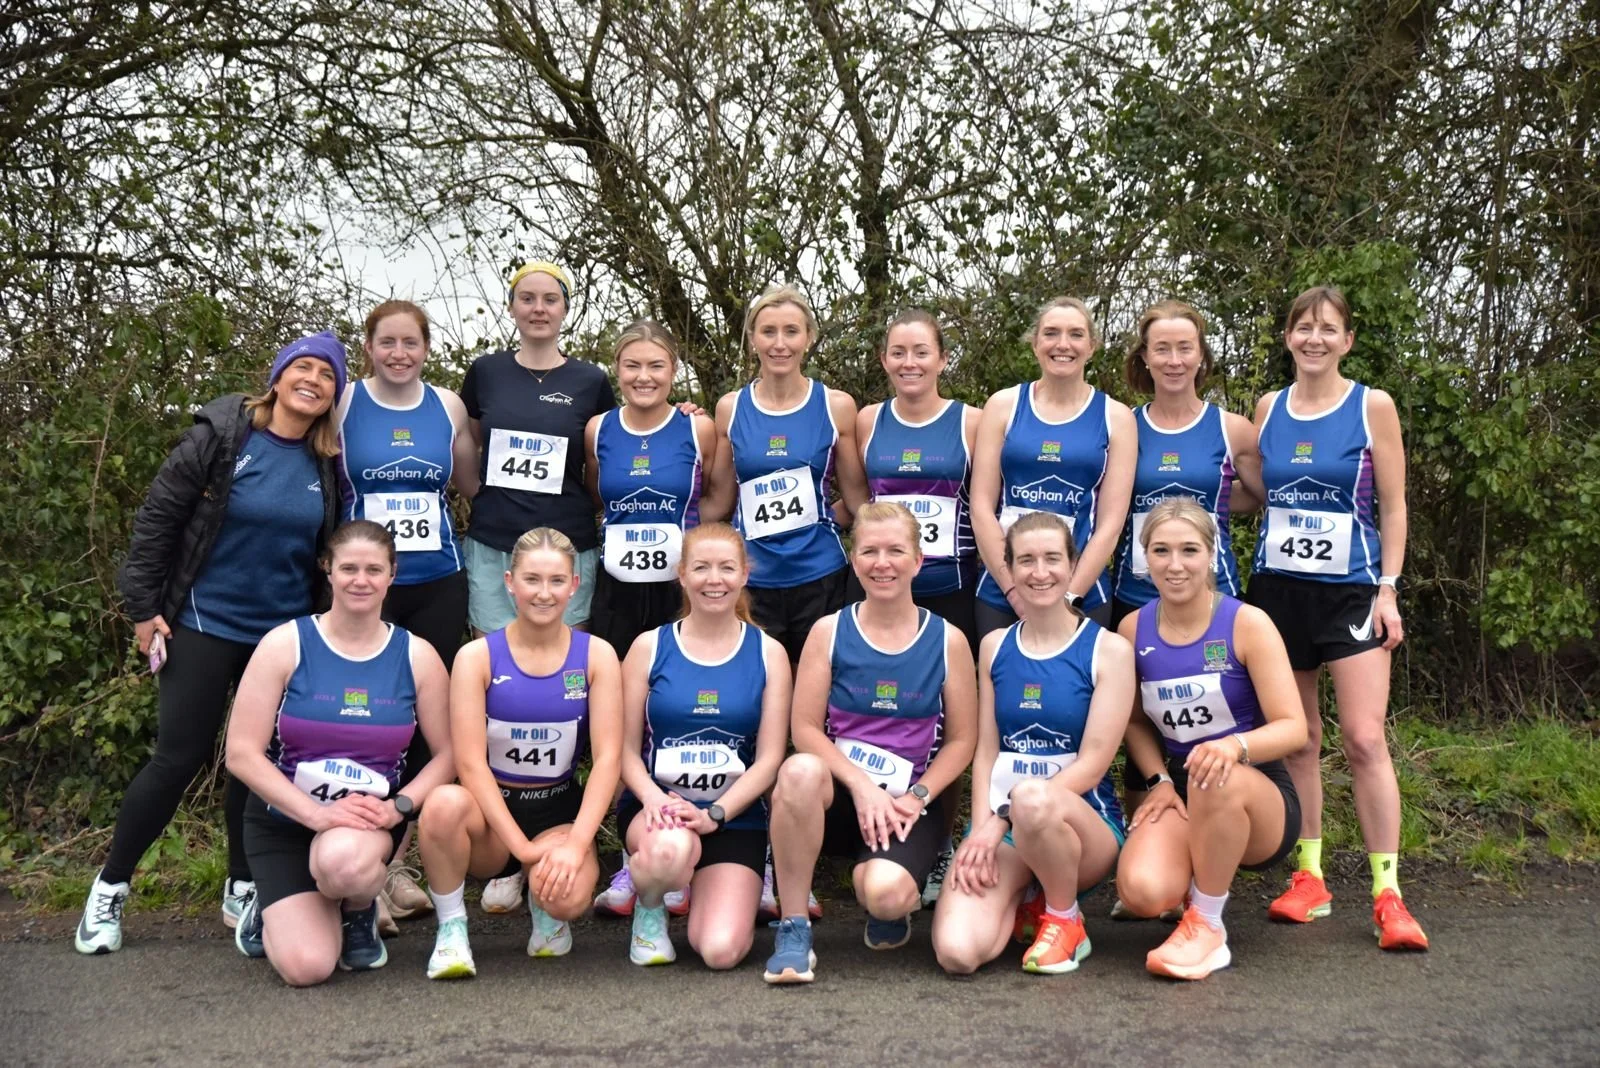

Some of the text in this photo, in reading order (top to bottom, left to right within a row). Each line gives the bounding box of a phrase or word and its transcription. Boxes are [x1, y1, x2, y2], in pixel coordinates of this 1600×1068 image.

[510, 435, 541, 451] Mr Oil
[362, 466, 443, 481] Croghan AC
[501, 457, 549, 480] 445
[754, 477, 787, 497] Mr Oil
[1011, 484, 1084, 504] Croghan AC
[386, 497, 421, 511] Mr Oil
[1268, 488, 1341, 505] Croghan AC
[609, 498, 677, 514] Croghan AC
[754, 496, 804, 524] 434
[914, 500, 930, 513] Oil
[384, 519, 430, 539] 436
[1289, 515, 1322, 530] Mr Oil
[625, 529, 657, 542] Mr Oil
[1280, 537, 1333, 561] 432
[619, 550, 668, 570] 438
[1158, 683, 1192, 700] Mr Oil
[1162, 705, 1213, 730] 443
[511, 727, 548, 740] Mr Oil
[505, 747, 557, 766] 441
[680, 750, 716, 764] Mr Oil
[849, 745, 886, 770] Mr Oil
[324, 760, 361, 780] Mr Oil
[1012, 759, 1048, 776] Mr Oil
[520, 789, 550, 800] NIKE
[551, 781, 570, 797] PRO
[674, 773, 726, 791] 440
[310, 783, 369, 802] 44
